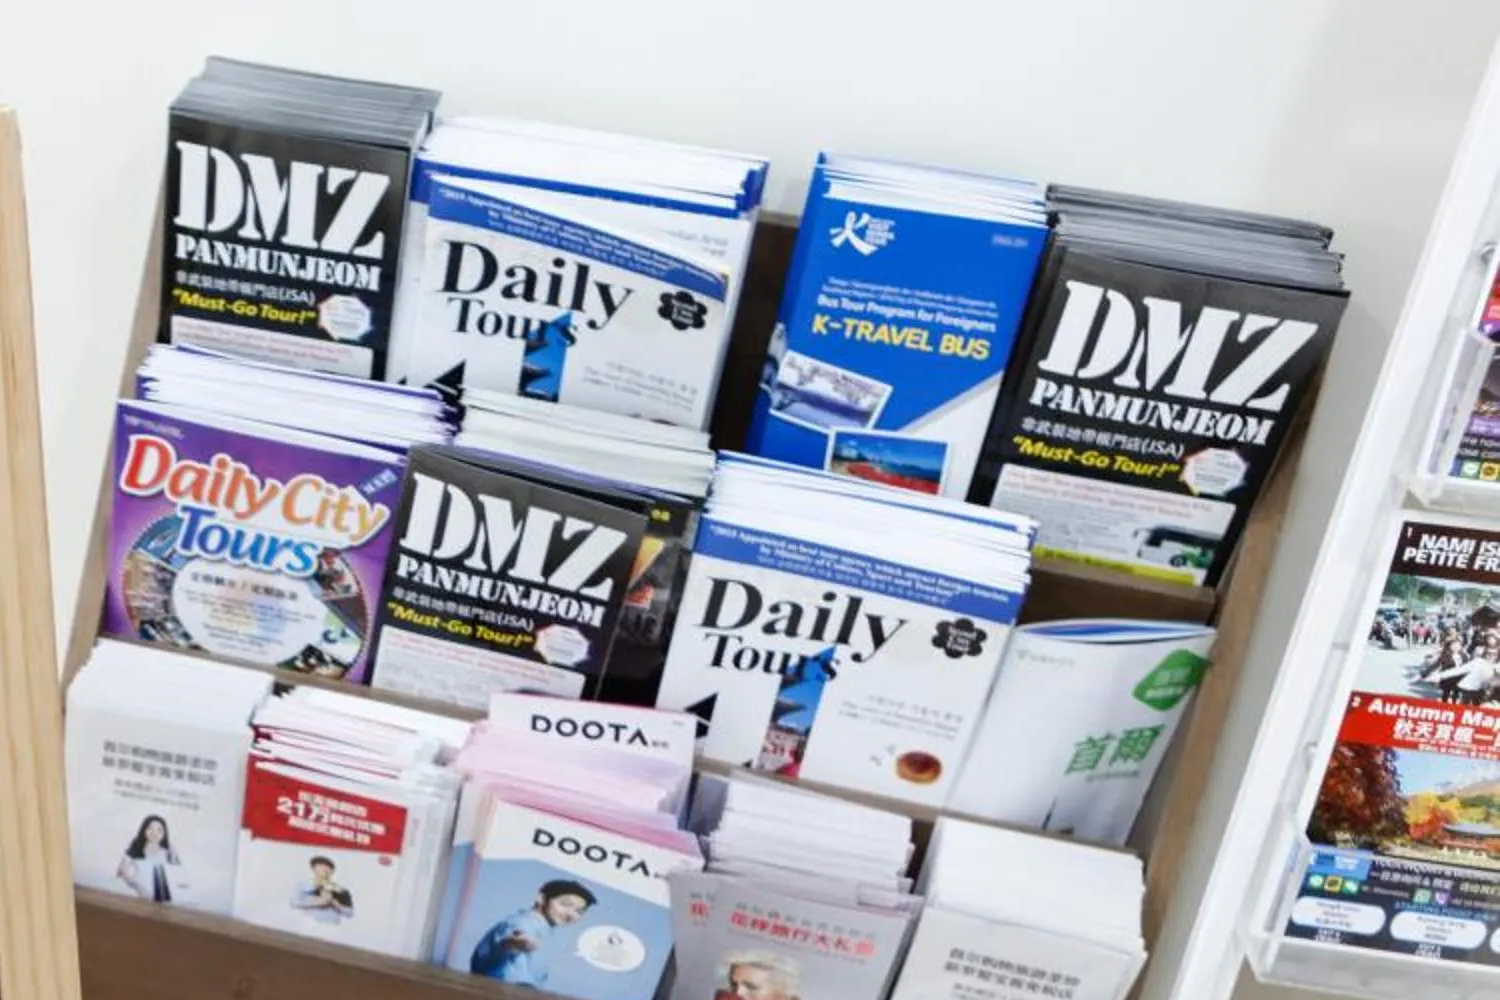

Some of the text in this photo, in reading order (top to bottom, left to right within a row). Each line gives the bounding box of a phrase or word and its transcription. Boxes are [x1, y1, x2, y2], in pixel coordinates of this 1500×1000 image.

[173, 140, 390, 259] DMZ
[174, 232, 383, 291] PANMUNJEOM
[437, 240, 636, 330] Daily
[447, 297, 579, 346] Tours
[812, 313, 991, 361] K-TRAVEL BUS
[1037, 279, 1318, 413] DMZ
[1028, 377, 1275, 446] PANMUNJEOM
[121, 435, 389, 542] Daily City
[180, 505, 320, 575] Tours
[399, 472, 627, 600] DMZ
[1402, 547, 1500, 572] PETITE FR
[1419, 533, 1500, 556] NAMI IS
[396, 553, 607, 628] PANMUNJEOM
[695, 576, 908, 663] Daily
[531, 713, 649, 747] DOOTA
[1367, 698, 1456, 723] Autumn
[532, 828, 651, 878] DOOTA
